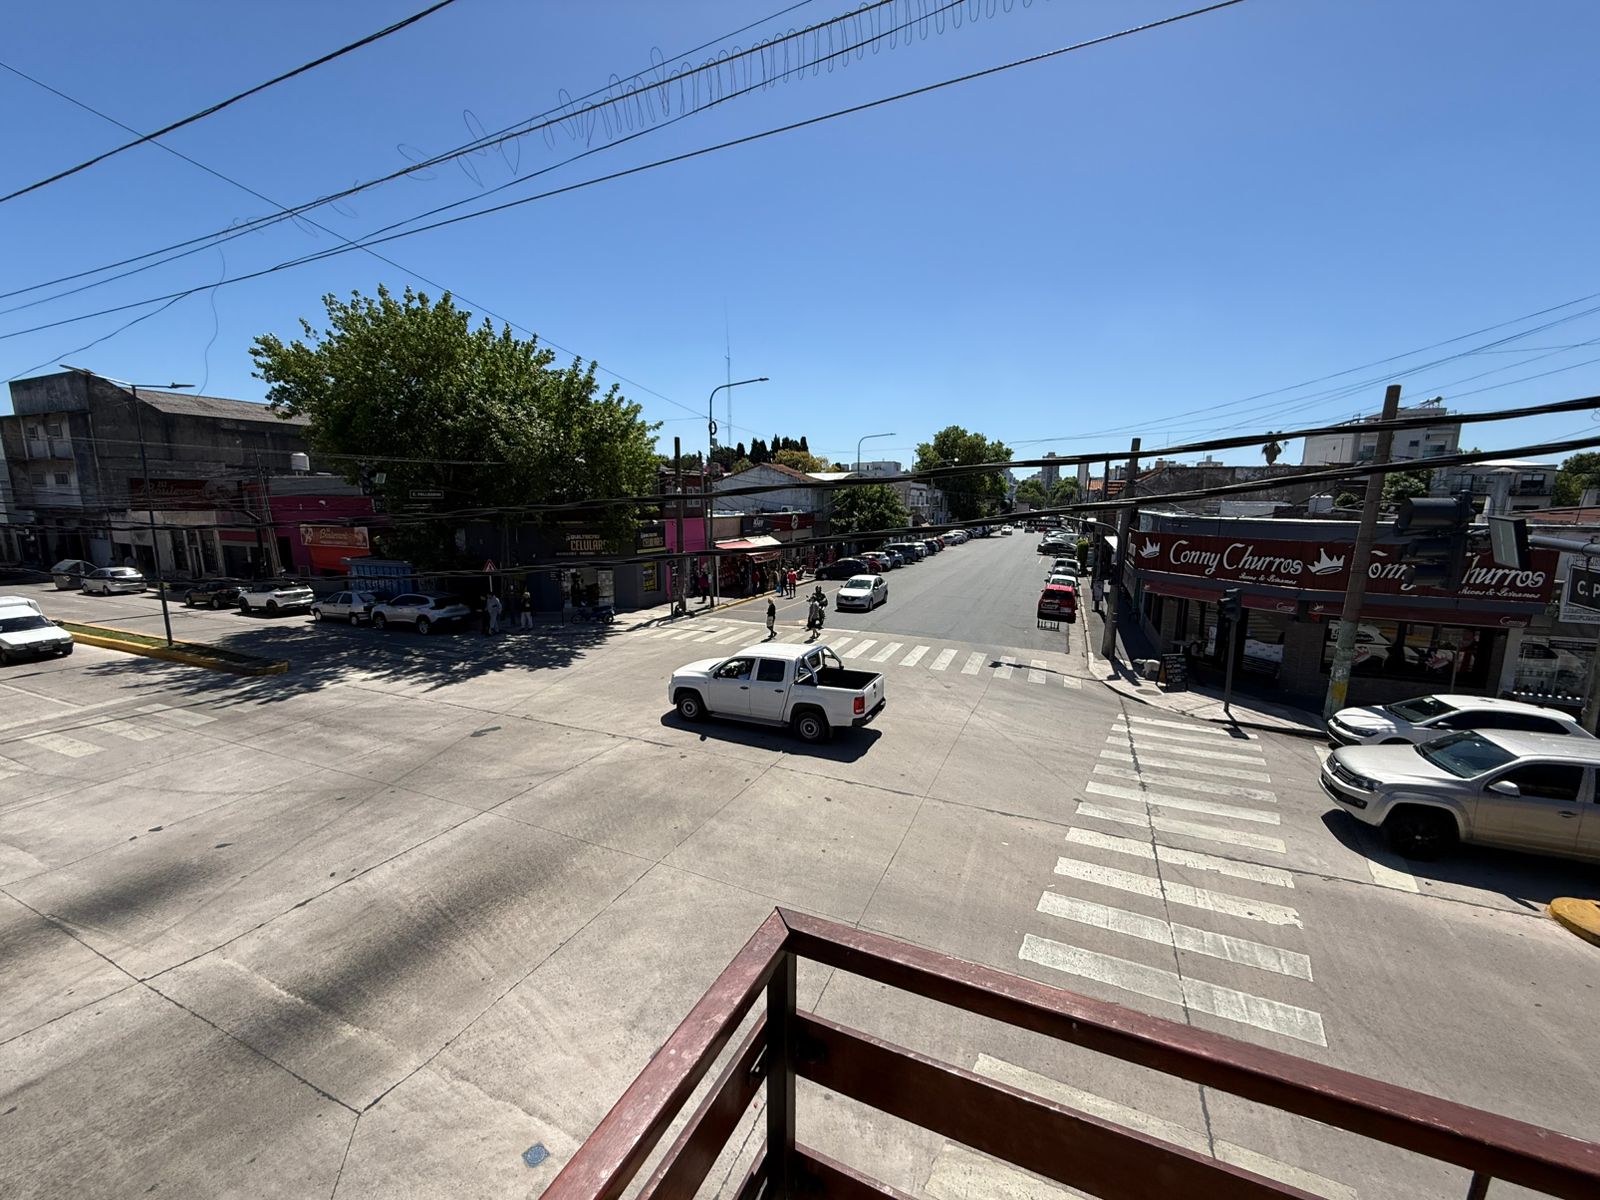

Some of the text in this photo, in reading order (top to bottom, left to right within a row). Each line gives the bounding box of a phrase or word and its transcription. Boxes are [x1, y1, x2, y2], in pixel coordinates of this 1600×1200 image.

[570, 540, 609, 551] CELULAR
[1169, 539, 1221, 576] Conny
[1223, 542, 1304, 575] Churros
[1367, 549, 1546, 591] onn hurros
[1486, 588, 1495, 597] &
[1576, 580, 1588, 597] C.
